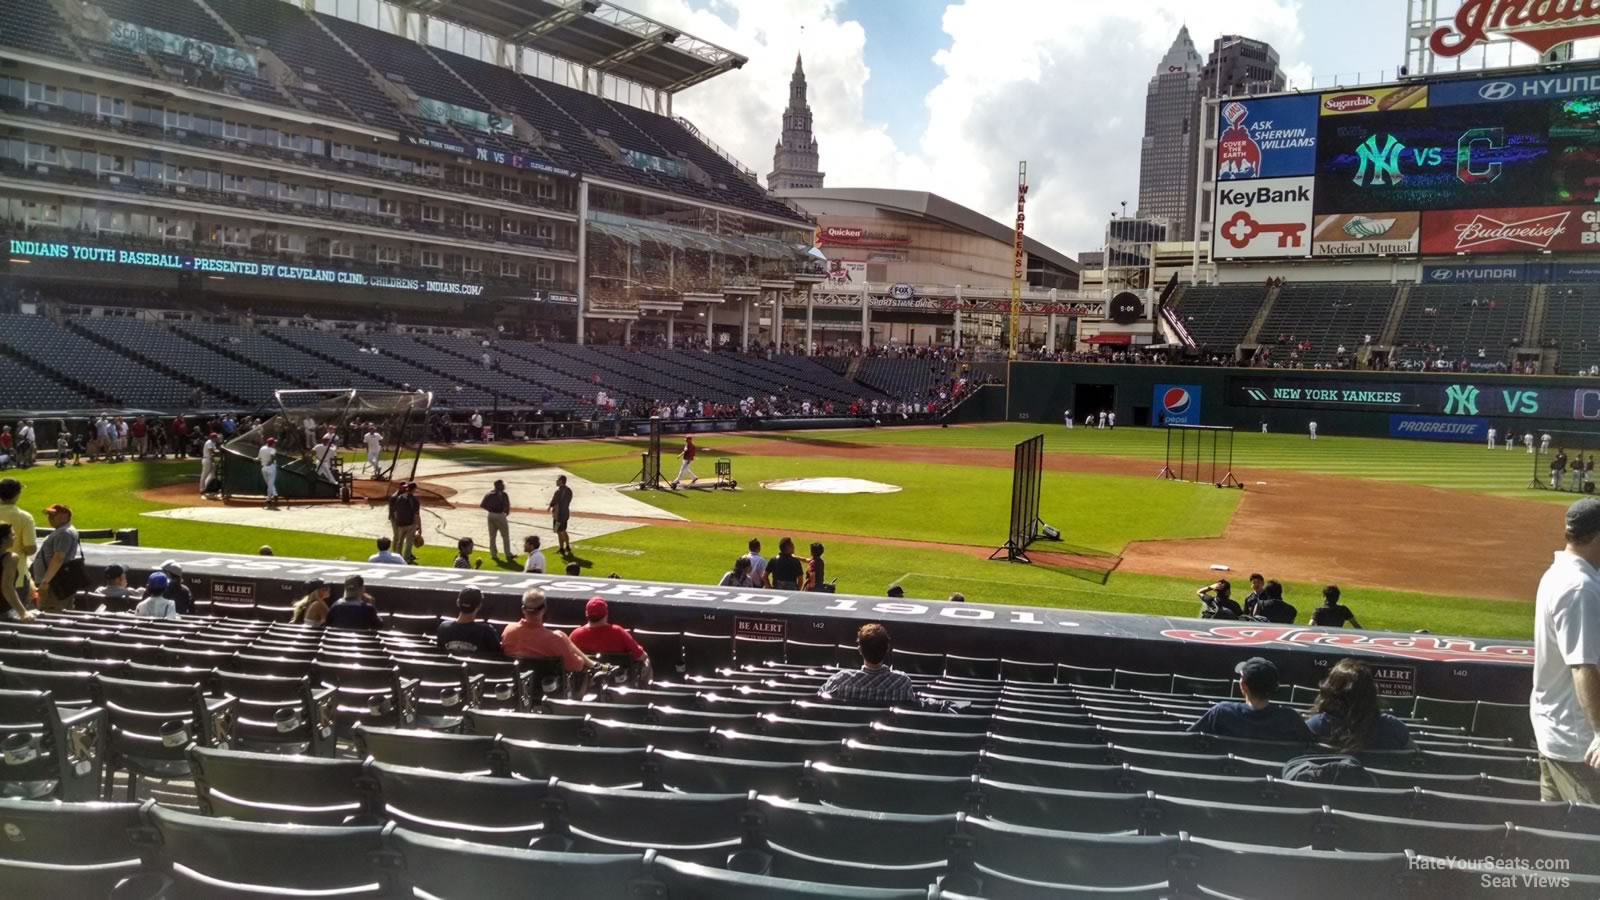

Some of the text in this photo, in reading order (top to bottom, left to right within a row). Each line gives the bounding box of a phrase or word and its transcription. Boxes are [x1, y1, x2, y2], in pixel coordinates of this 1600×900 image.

[1326, 96, 1375, 110] Sugardale
[1251, 121, 1273, 130] ASK
[1254, 128, 1306, 140] SHERWIN
[1261, 138, 1315, 149] WILLIAMS
[494, 152, 504, 164] VS
[1413, 147, 1442, 166] VS
[1220, 185, 1310, 207] KeyBank
[828, 228, 861, 237] Quicken
[1015, 186, 1028, 267] WALGREENS
[1454, 222, 1566, 241] Budweiser
[1320, 241, 1411, 254] Medical Mutual
[10, 240, 68, 257] INDIANS
[72, 246, 116, 262] YOUTH
[119, 251, 182, 268] BASEBALL
[194, 257, 258, 275] PRESENTED
[261, 265, 275, 276] BY
[277, 266, 335, 282] CLEVELAND
[338, 271, 368, 285] CLINIC
[370, 276, 418, 290] CHILDRENS
[1456, 269, 1517, 278] HYUNDAI
[894, 286, 909, 294] FOX
[1274, 388, 1301, 399] NEW
[1305, 389, 1338, 400] YORK
[1342, 391, 1401, 403] YANKEES
[1503, 390, 1538, 414] VS
[1165, 416, 1187, 424] pepsi
[1398, 420, 1479, 434] PROGRESSIVE
[214, 584, 252, 594] BE ALERT
[739, 622, 783, 632] BE ALERT
[1314, 659, 1327, 667] 142
[1374, 669, 1411, 680] ALERT
